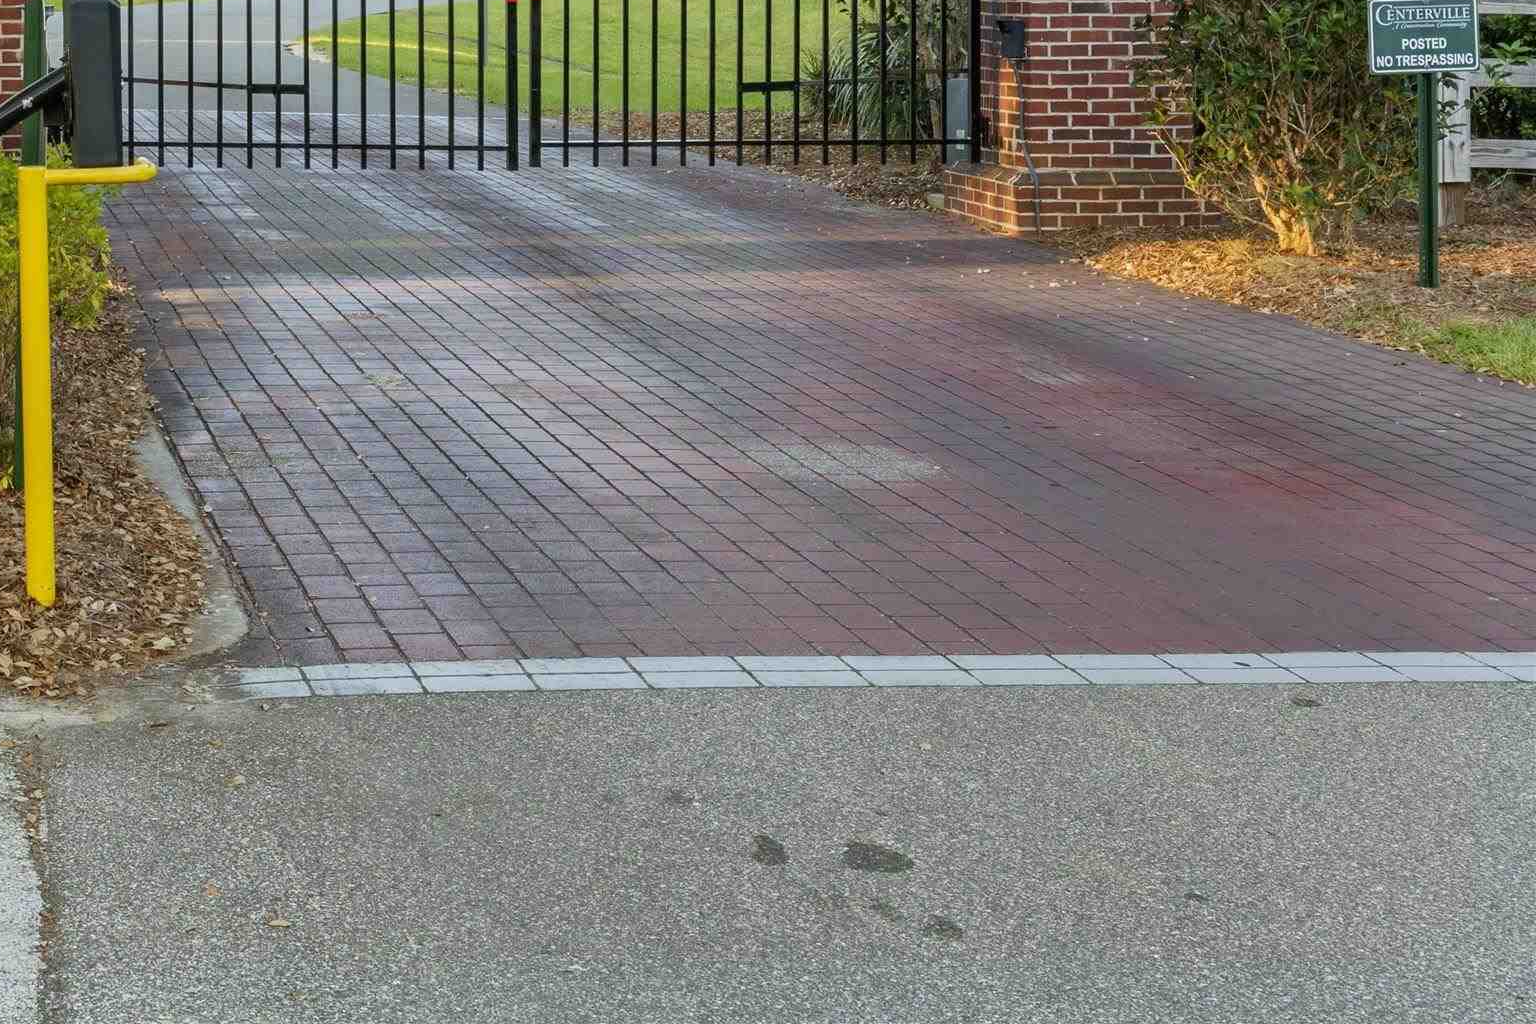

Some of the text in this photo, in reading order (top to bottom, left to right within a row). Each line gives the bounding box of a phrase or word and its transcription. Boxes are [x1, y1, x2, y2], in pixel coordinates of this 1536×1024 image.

[1375, 4, 1471, 26] CENTERVILLE
[1401, 37, 1448, 50] POSTED
[1376, 53, 1474, 68] NO TRESPASSING
